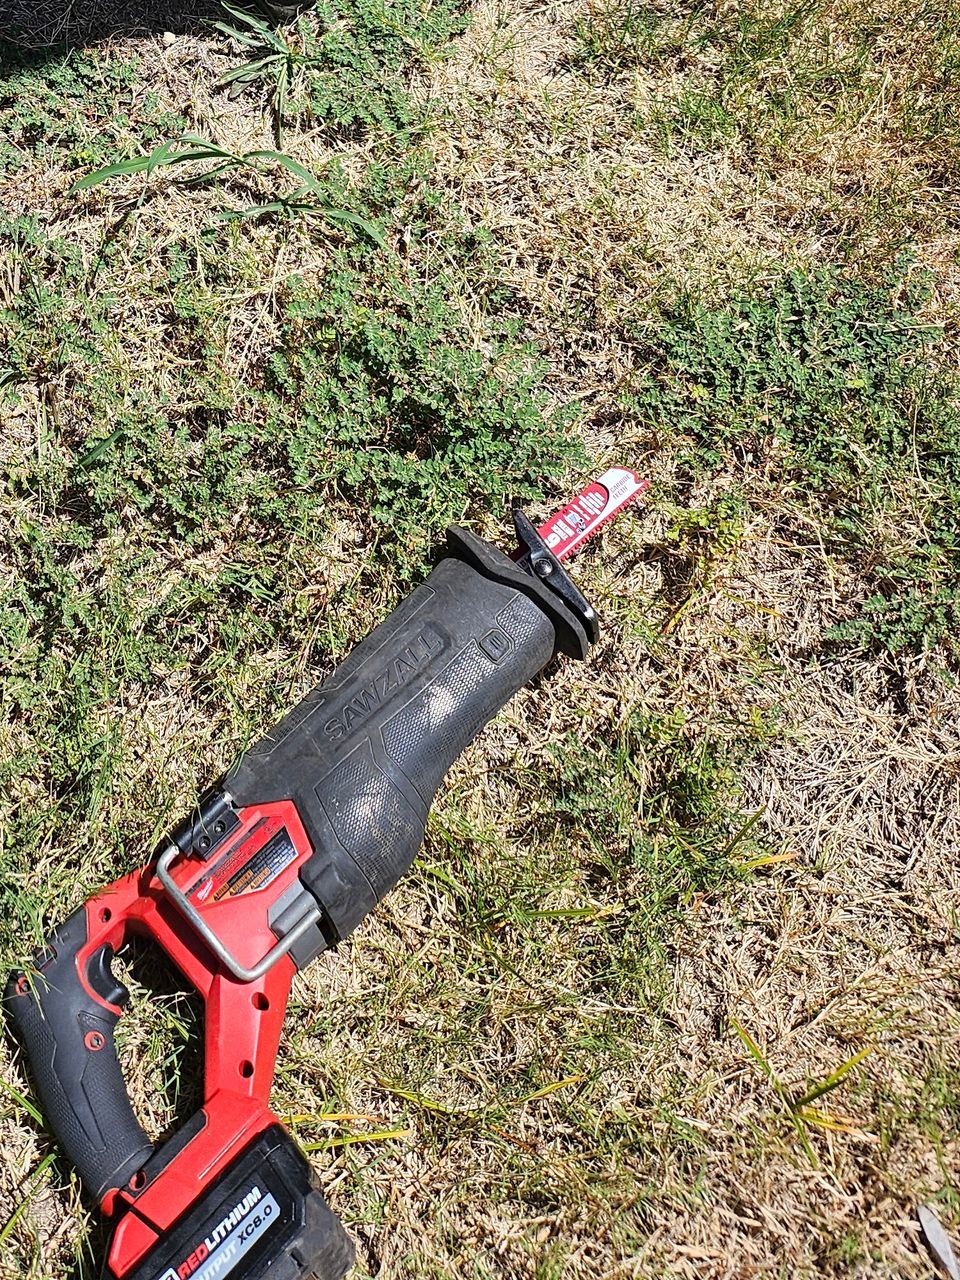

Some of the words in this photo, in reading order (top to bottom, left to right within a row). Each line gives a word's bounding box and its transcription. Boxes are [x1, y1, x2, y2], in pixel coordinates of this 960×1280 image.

[324, 635, 442, 742] SAWZALL
[177, 1186, 262, 1280] REDLITHIUM
[237, 1204, 273, 1246] XC8.0
